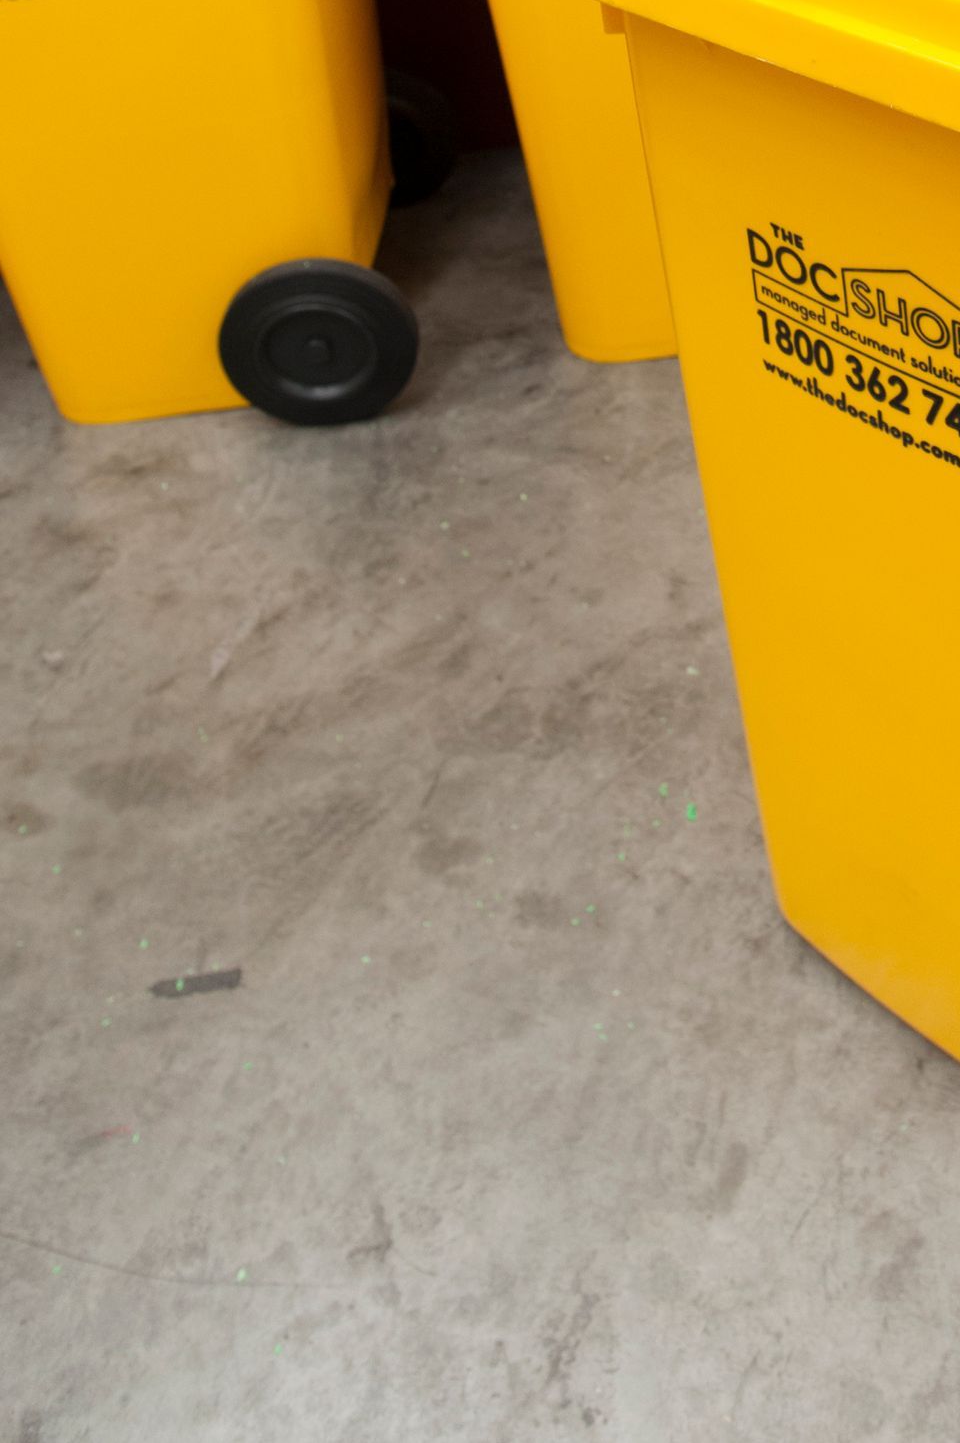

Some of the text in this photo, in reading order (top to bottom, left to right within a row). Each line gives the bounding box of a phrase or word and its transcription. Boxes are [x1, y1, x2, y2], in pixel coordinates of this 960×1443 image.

[747, 228, 840, 303] DOC
[769, 222, 805, 250] THE
[757, 309, 834, 377] 1800
[845, 354, 911, 415] 362
[761, 284, 827, 325] managed
[831, 314, 906, 364] document
